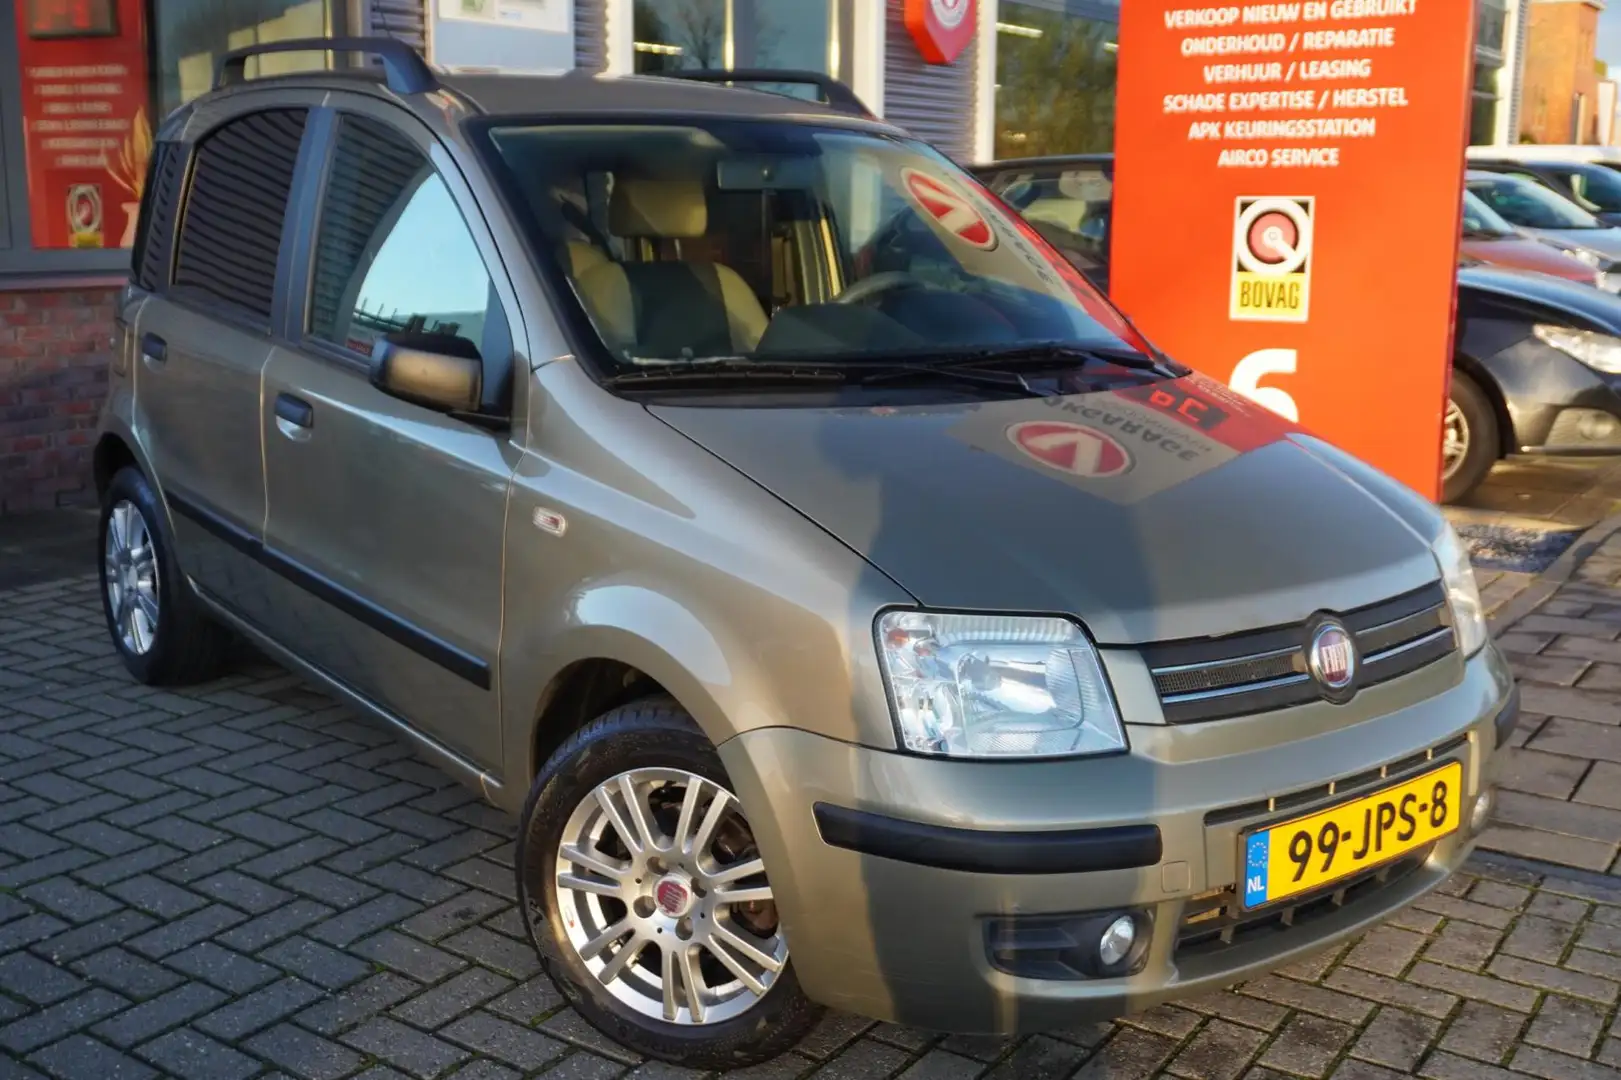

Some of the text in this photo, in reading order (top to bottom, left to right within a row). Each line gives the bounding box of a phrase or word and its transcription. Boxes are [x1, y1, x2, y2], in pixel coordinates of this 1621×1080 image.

[1164, 0, 1416, 28] VERKOOP NIEUW EN GEBRUIKT
[1181, 33, 1286, 56] ONDERHOUD
[1303, 27, 1395, 50] REPARATIE
[1204, 62, 1281, 83] VERHUUR
[1300, 58, 1371, 79] LEASING
[1163, 93, 1225, 113] SCHADE
[1229, 90, 1315, 111] EXPERTISE
[1333, 87, 1408, 107] HERSTEL
[1188, 117, 1375, 140] APK KEURINGSSTATION
[1217, 148, 1339, 167] AIRCO SERVICE
[1239, 280, 1299, 309] BOVAG
[1289, 780, 1448, 883] 99-JPS-8
[1247, 875, 1265, 894] NL
